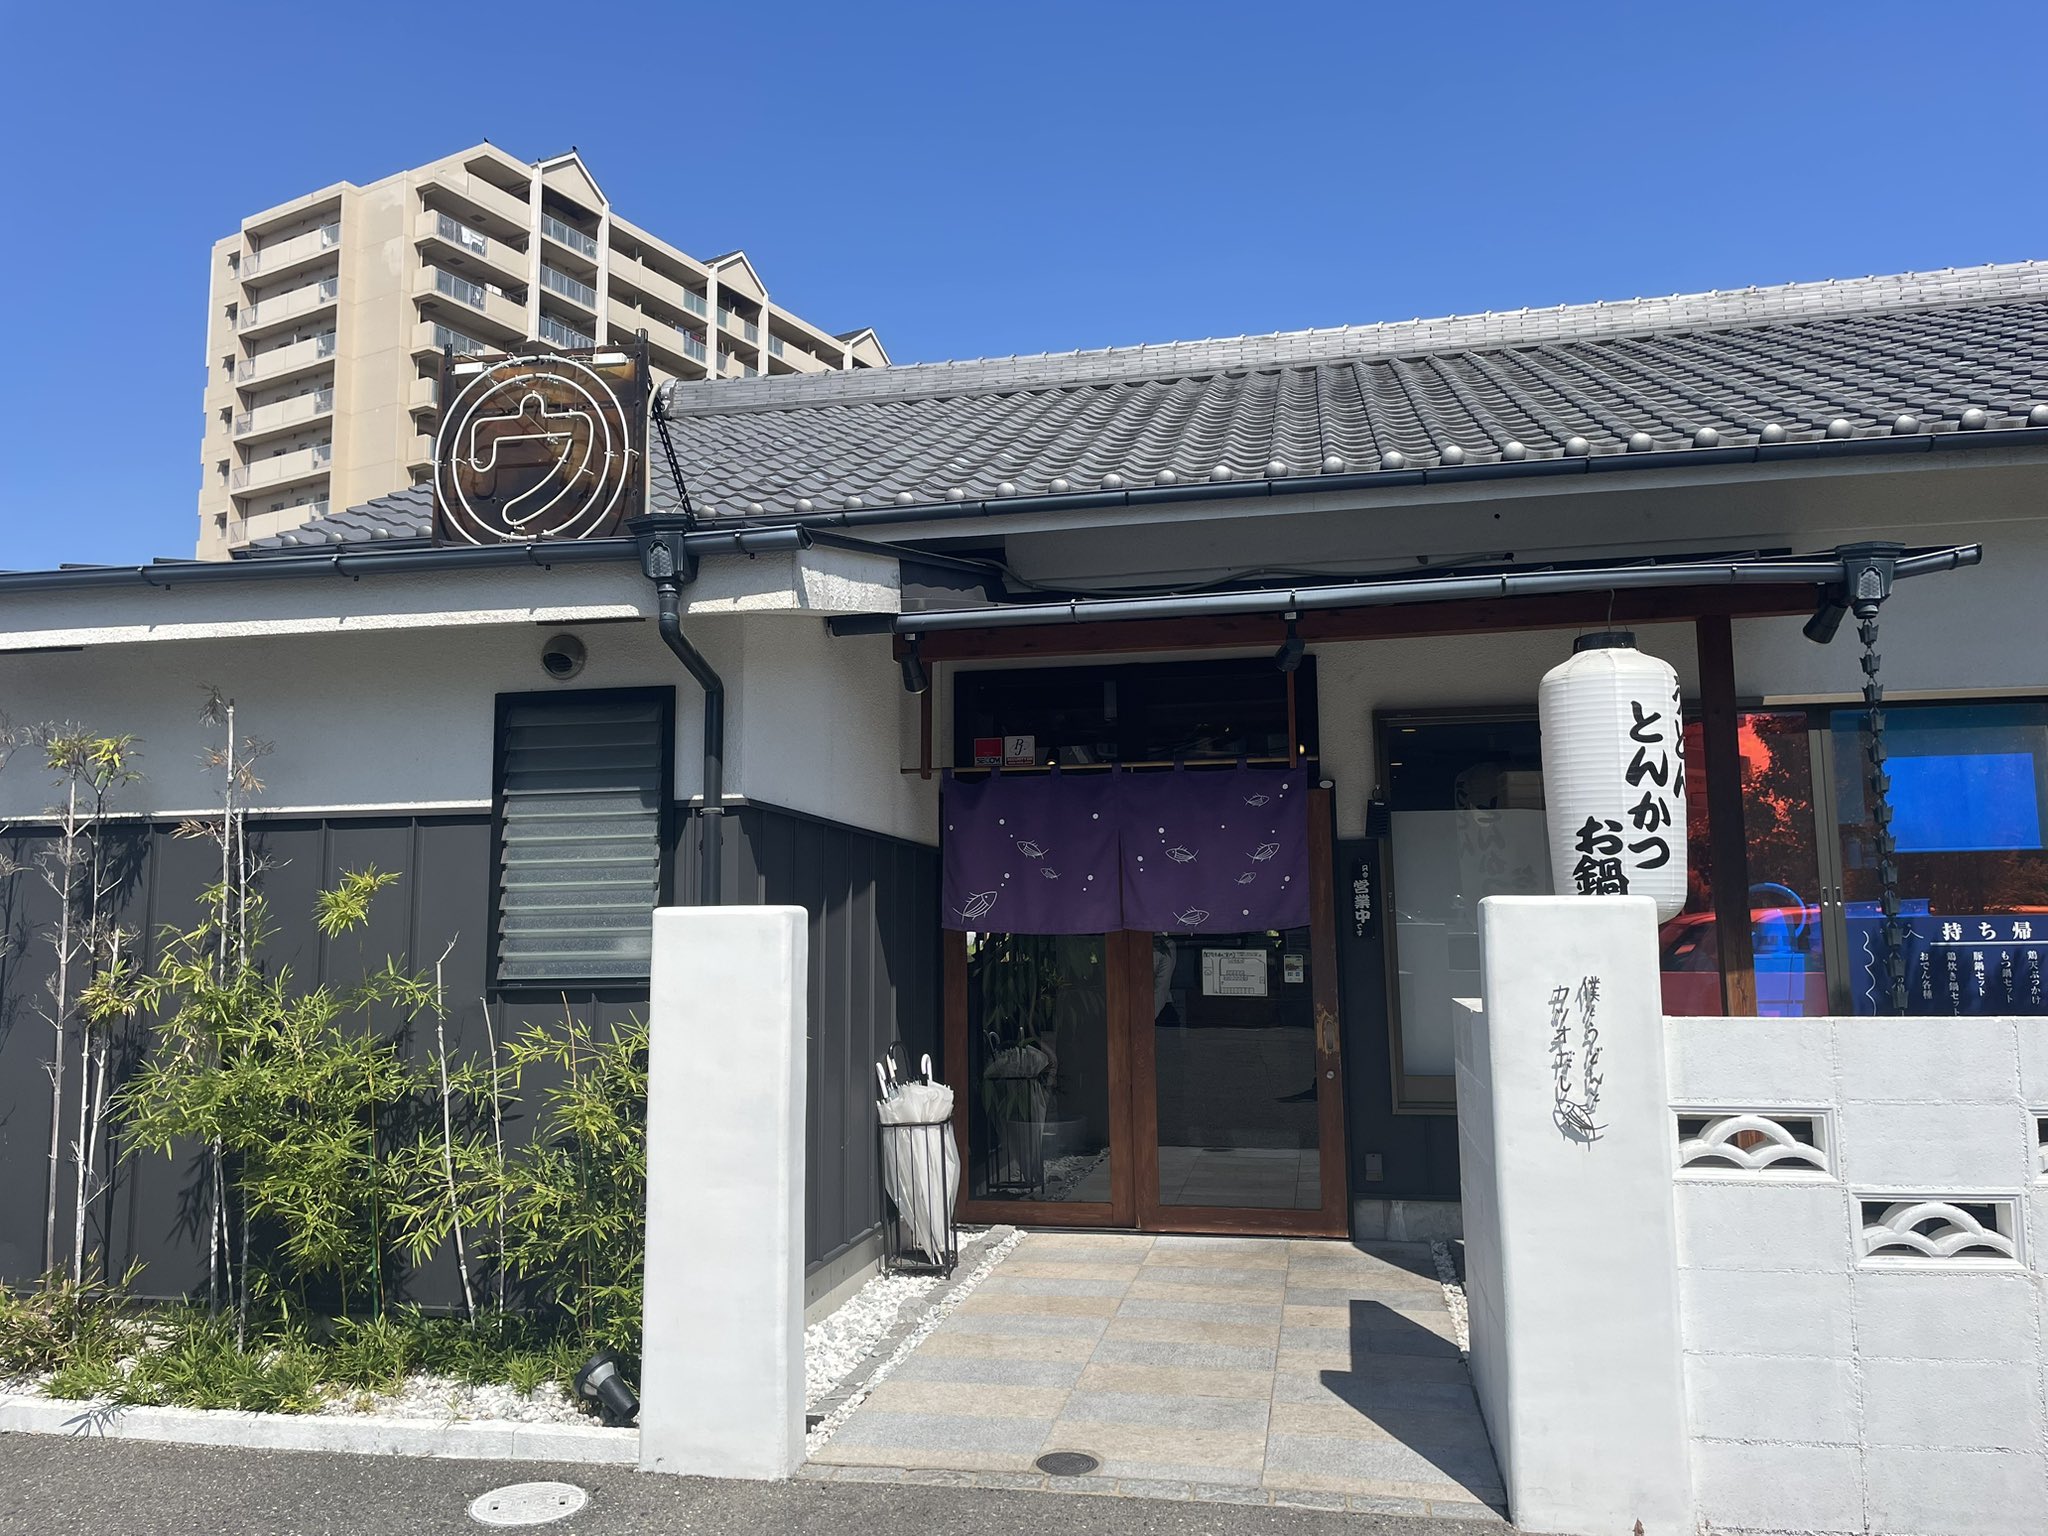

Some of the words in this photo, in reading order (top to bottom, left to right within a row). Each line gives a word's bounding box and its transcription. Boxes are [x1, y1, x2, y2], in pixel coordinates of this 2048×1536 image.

[1625, 700, 1671, 869] とんかつ
[1573, 815, 1630, 895] お鍋
[1919, 951, 1933, 1000] おでん各種
[1973, 951, 1986, 997] 豚鍋セット
[2000, 950, 2014, 1004] もつ鍋セット
